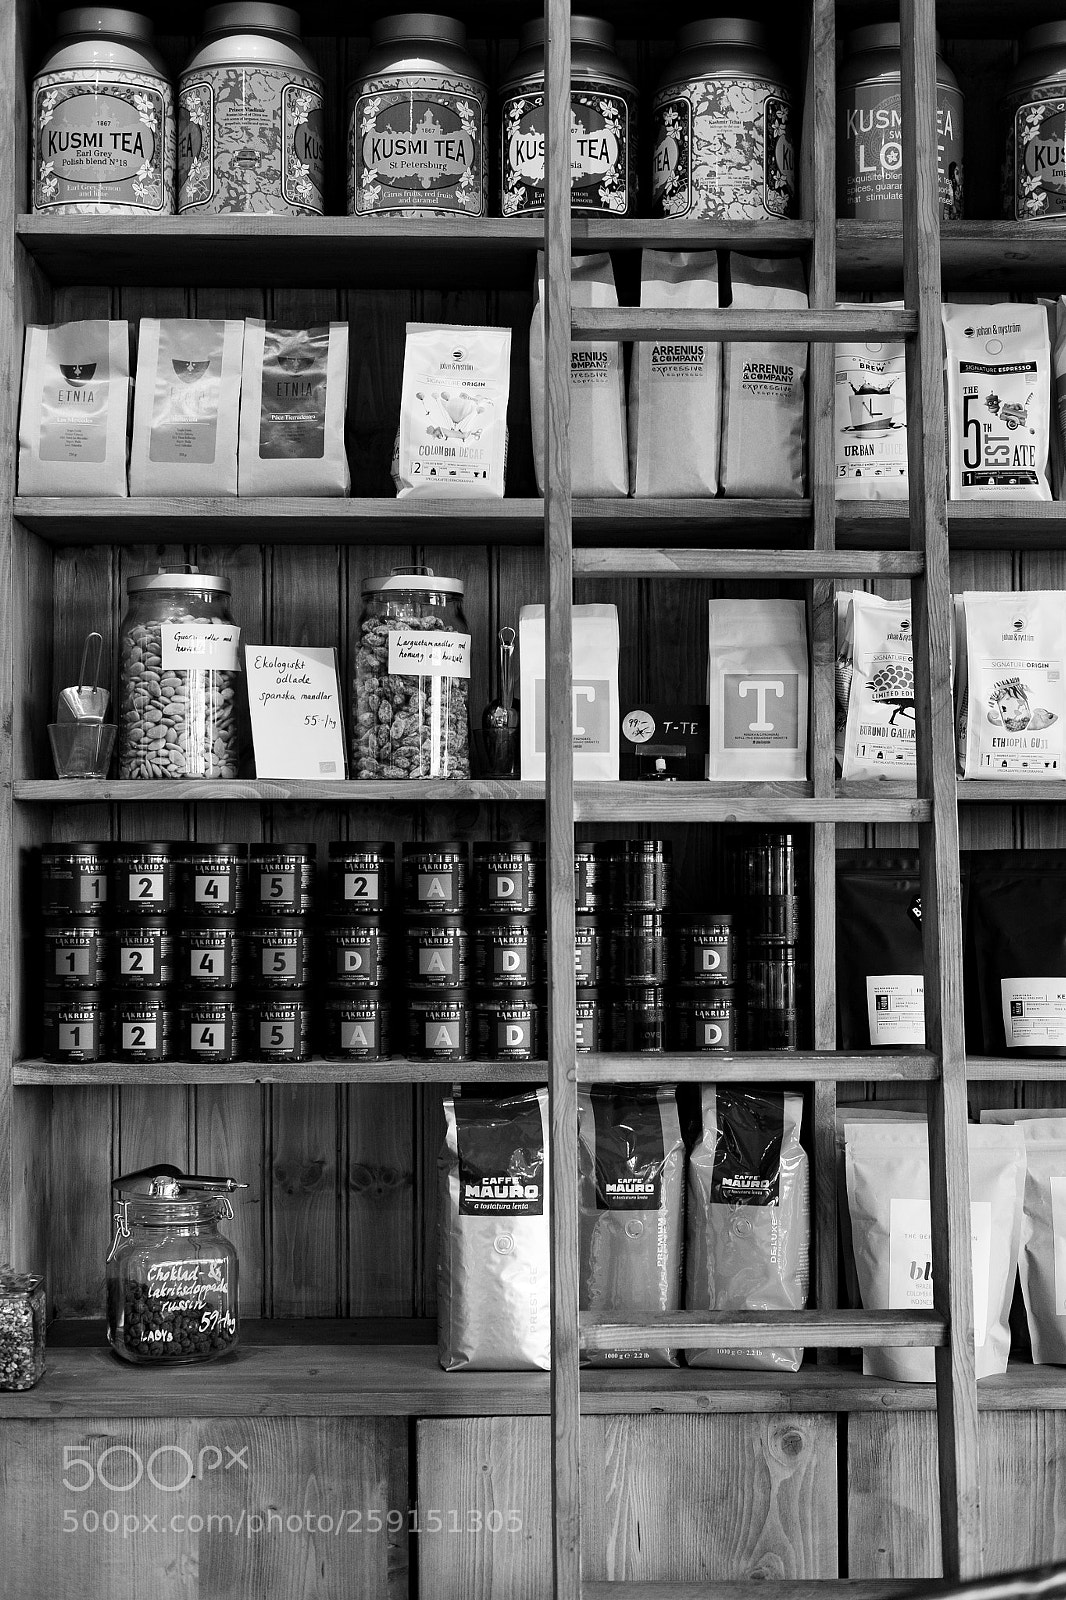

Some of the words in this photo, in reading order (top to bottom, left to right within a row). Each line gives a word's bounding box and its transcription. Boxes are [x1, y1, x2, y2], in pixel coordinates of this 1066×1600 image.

[49, 130, 104, 157] KUSMI
[110, 132, 145, 158] TEA
[76, 150, 92, 158] Earl
[94, 150, 112, 159] Grey
[371, 138, 428, 163] KUSMI
[434, 139, 466, 165] TEA
[577, 138, 610, 165] TEA
[62, 158, 81, 167] Polish
[82, 158, 107, 166] blend
[389, 161, 399, 169] St
[401, 160, 448, 171] Petersburg
[976, 325, 992, 337] johan
[992, 325, 998, 335] &
[998, 322, 1022, 337] nyström
[652, 345, 704, 356] ARRENIUS
[571, 361, 608, 369] OMPANY
[659, 355, 704, 363] COMPANY
[652, 366, 703, 377] expressive
[743, 362, 794, 376] ARRENIUS
[859, 363, 885, 373] BREW
[965, 364, 997, 373] SIGNATURE
[998, 364, 1032, 373] ESPRESSO
[743, 372, 749, 380] &
[750, 372, 793, 383] COMPANY
[58, 389, 94, 402] ETNIA
[277, 382, 312, 397] ETNIA
[742, 384, 792, 395] expressive
[963, 386, 979, 394] THE
[963, 395, 982, 469] 5
[983, 423, 992, 433] TH
[419, 445, 456, 457] COLOMBIA
[844, 444, 875, 457] URBAN
[984, 434, 1010, 467] EST
[1013, 445, 1036, 467] ATE
[414, 462, 421, 474] 2
[839, 465, 847, 477] 3
[966, 473, 972, 485] 1
[873, 654, 907, 662] SIGNATURE
[254, 656, 306, 674] Ekologiskt
[276, 674, 312, 684] odlade
[259, 691, 296, 706] spanska
[300, 692, 333, 701] mandlar
[872, 690, 899, 699] LIMITED
[738, 680, 785, 731] T
[663, 721, 699, 735] T-TE
[860, 725, 889, 738] BURUNDI
[992, 737, 1028, 749] ETHIOPIA
[861, 744, 866, 757] 1
[985, 755, 991, 766] 1
[129, 864, 164, 873] LAKRIDS
[195, 865, 230, 874] LAKRIDS
[261, 864, 295, 873] LAKRIDS
[345, 863, 379, 871] LAKRIDS
[418, 863, 453, 872] LAKRIDS
[488, 863, 523, 871] LAKRIDS
[91, 879, 100, 899] 1
[138, 878, 153, 898] 2
[204, 879, 219, 899] 4
[270, 878, 283, 898] 5
[354, 877, 368, 897] 2
[427, 878, 445, 897] A
[497, 877, 515, 897] D
[55, 938, 91, 947] LAKRIDS
[120, 937, 154, 946] LAKRIDS
[191, 938, 225, 947] LAKRIDS
[262, 937, 298, 946] LAKRIDS
[336, 937, 371, 946] LAKRIDS
[419, 937, 453, 946] LAKRIDS
[493, 937, 528, 946] LAKRIDS
[694, 936, 728, 945] LAKRIDS
[65, 953, 74, 972] 1
[129, 952, 143, 971] 2
[200, 953, 214, 973] 4
[273, 952, 286, 971] 5
[344, 951, 362, 971] D
[427, 952, 446, 971] A
[502, 950, 520, 970] D
[703, 950, 721, 970] D
[59, 1012, 94, 1021] LAKRIDS
[122, 1011, 156, 1020] LAKRIDS
[191, 1012, 226, 1021] LAKRIDS
[260, 1011, 295, 1020] LAKRIDS
[341, 1011, 376, 1020] LAKRIDS
[425, 1011, 460, 1020] LAKRIDS
[497, 1011, 531, 1020] LAKRIDS
[695, 1010, 730, 1019] LAKRIDS
[70, 1026, 80, 1046] 1
[131, 1026, 146, 1046] 2
[200, 1027, 214, 1046] 4
[270, 1026, 284, 1045] 5
[350, 1026, 368, 1045] A
[434, 1026, 452, 1045] A
[506, 1025, 524, 1045] D
[705, 1024, 722, 1045] D
[606, 1183, 655, 1193] MAURO
[722, 1177, 770, 1188] MAURO
[465, 1185, 539, 1199] MAURO
[480, 1202, 511, 1210] tostatura
[512, 1202, 529, 1210] lenta
[162, 1299, 207, 1313] russin
